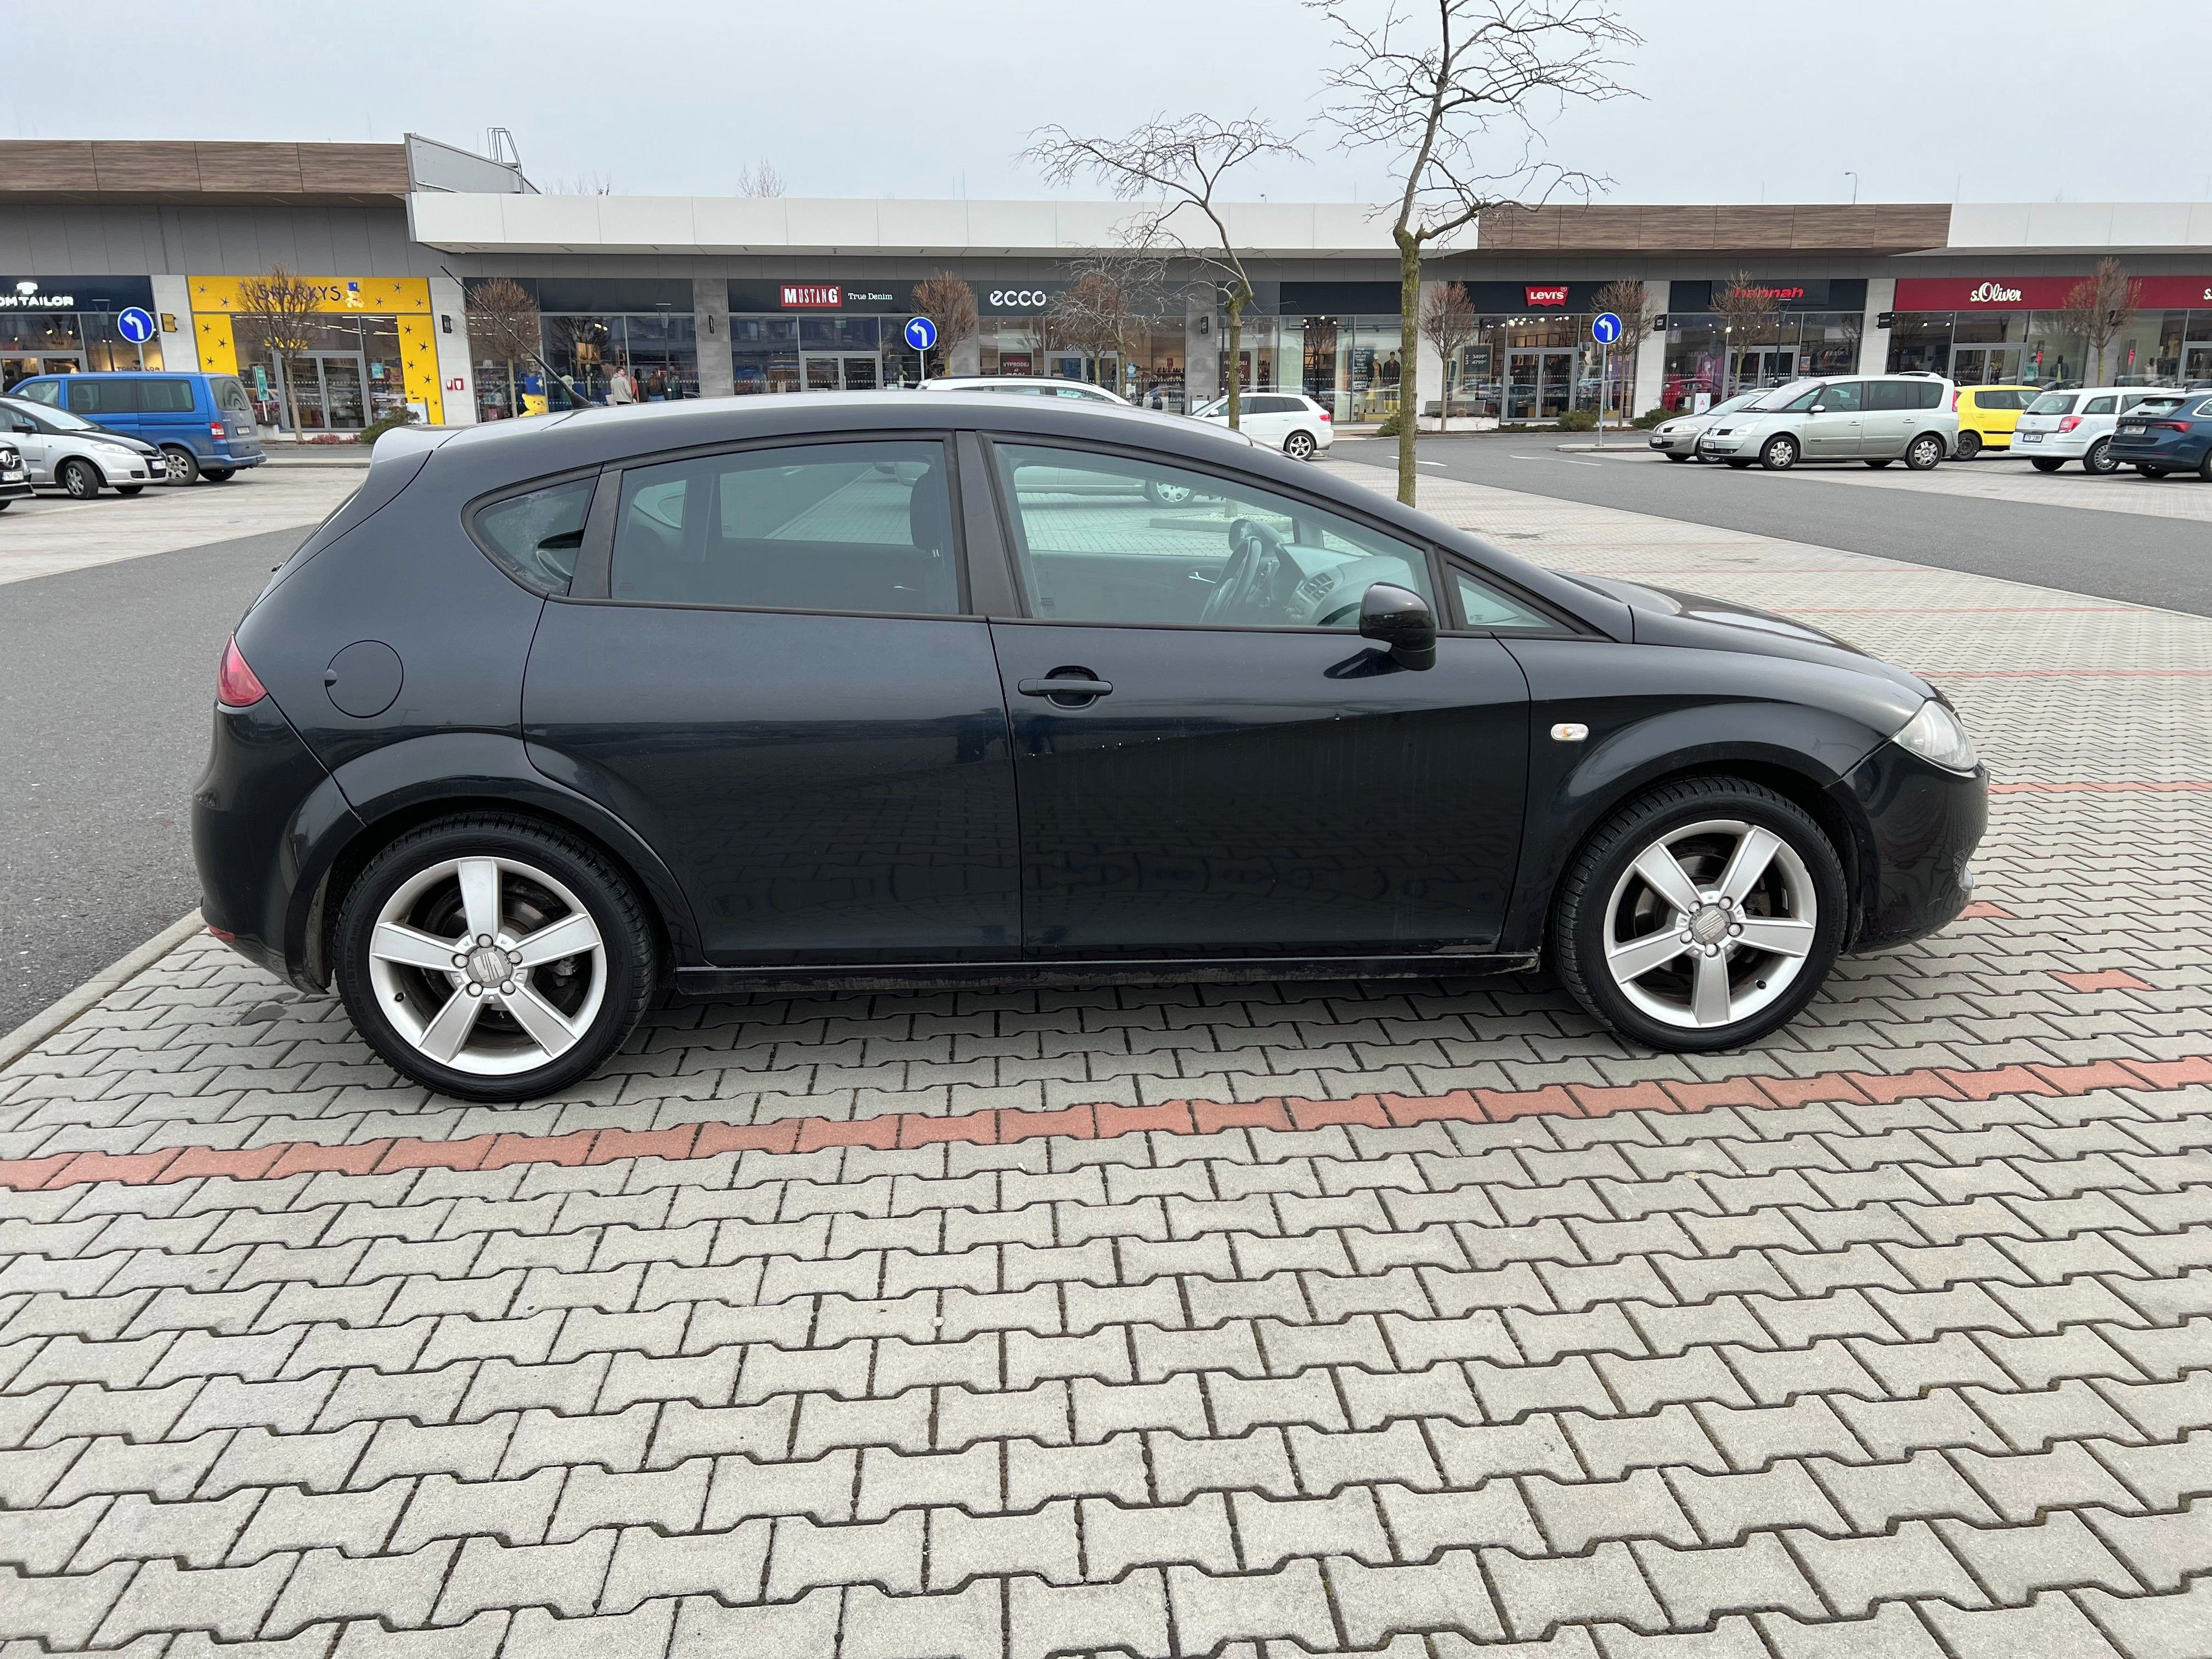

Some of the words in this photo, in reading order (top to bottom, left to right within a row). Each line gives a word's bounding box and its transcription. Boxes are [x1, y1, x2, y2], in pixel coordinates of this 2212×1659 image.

[784, 288, 838, 303] MUSTANG
[990, 290, 1047, 306] ecco
[1734, 287, 1804, 298] hannah
[1970, 282, 2022, 302] s.Oliver
[18, 296, 74, 306] TAILOR
